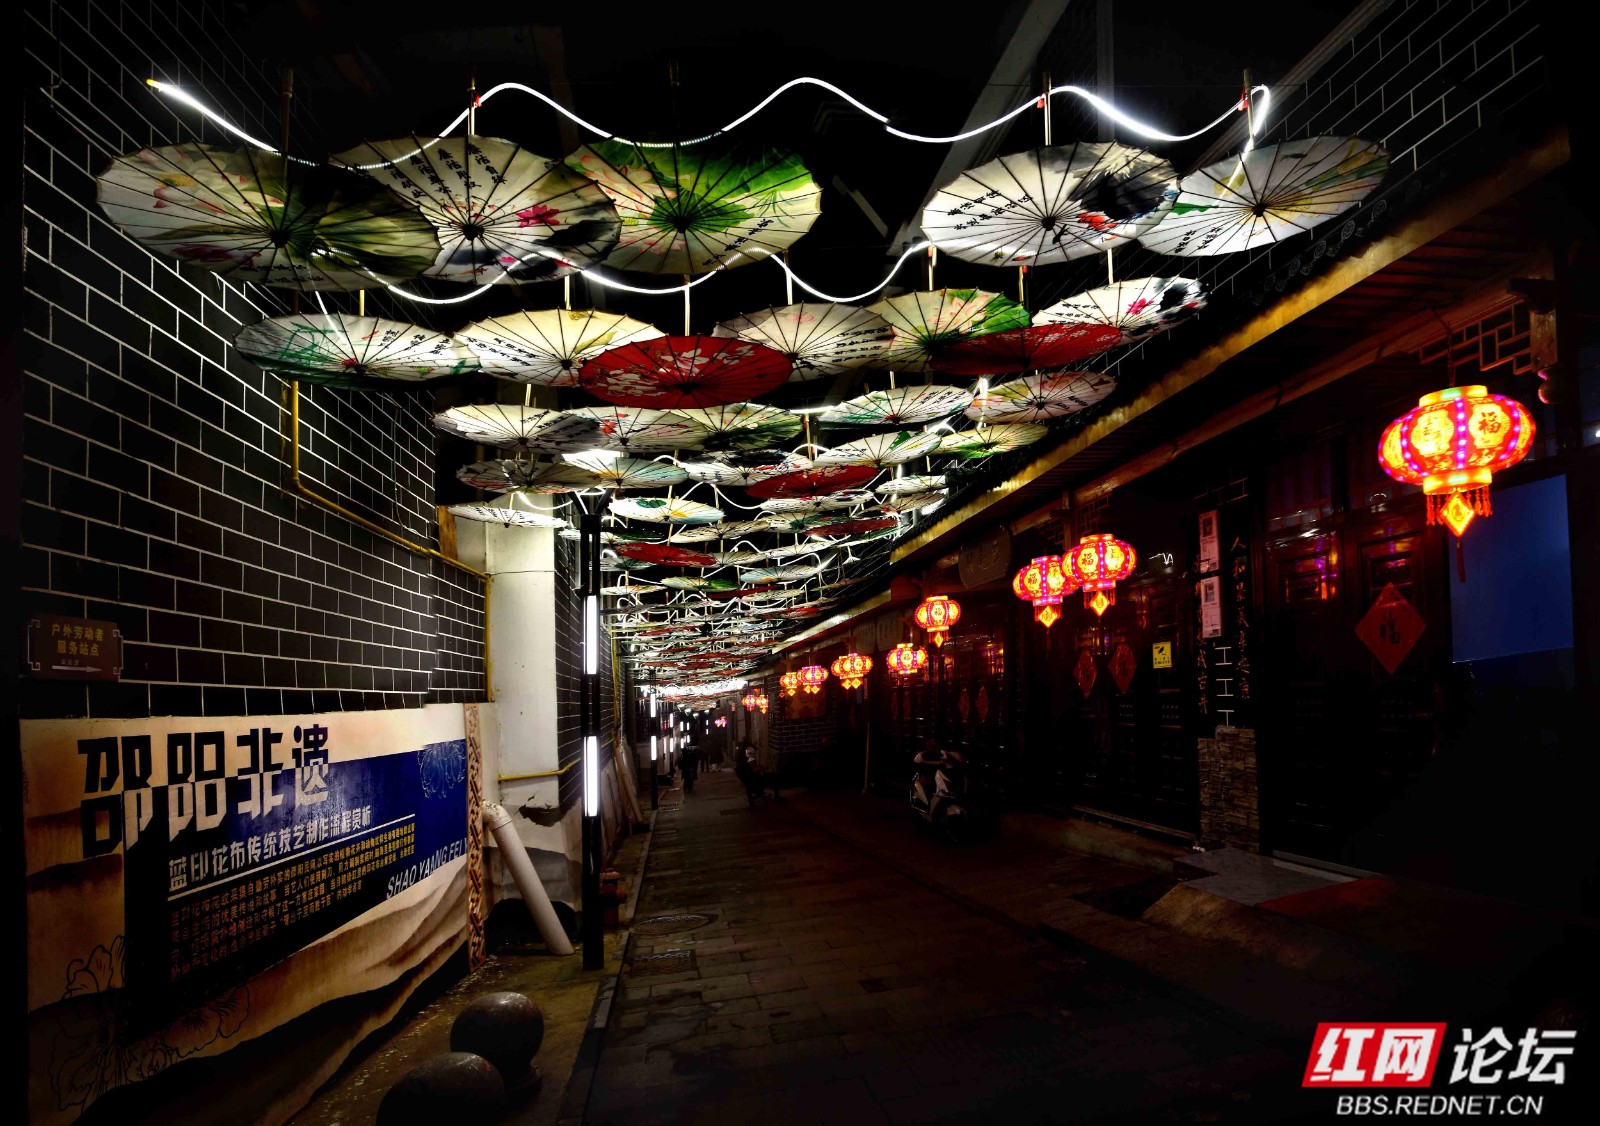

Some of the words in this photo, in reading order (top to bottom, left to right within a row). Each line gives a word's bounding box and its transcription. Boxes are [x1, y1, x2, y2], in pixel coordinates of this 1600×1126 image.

[1478, 411, 1501, 434] 福
[51, 623, 104, 642] 户外劳动者
[57, 640, 99, 657] 服务站点
[168, 805, 372, 892] 蓝印花布传统技艺制作流程赏析
[386, 865, 417, 900] SHAO
[448, 838, 463, 861] FEI
